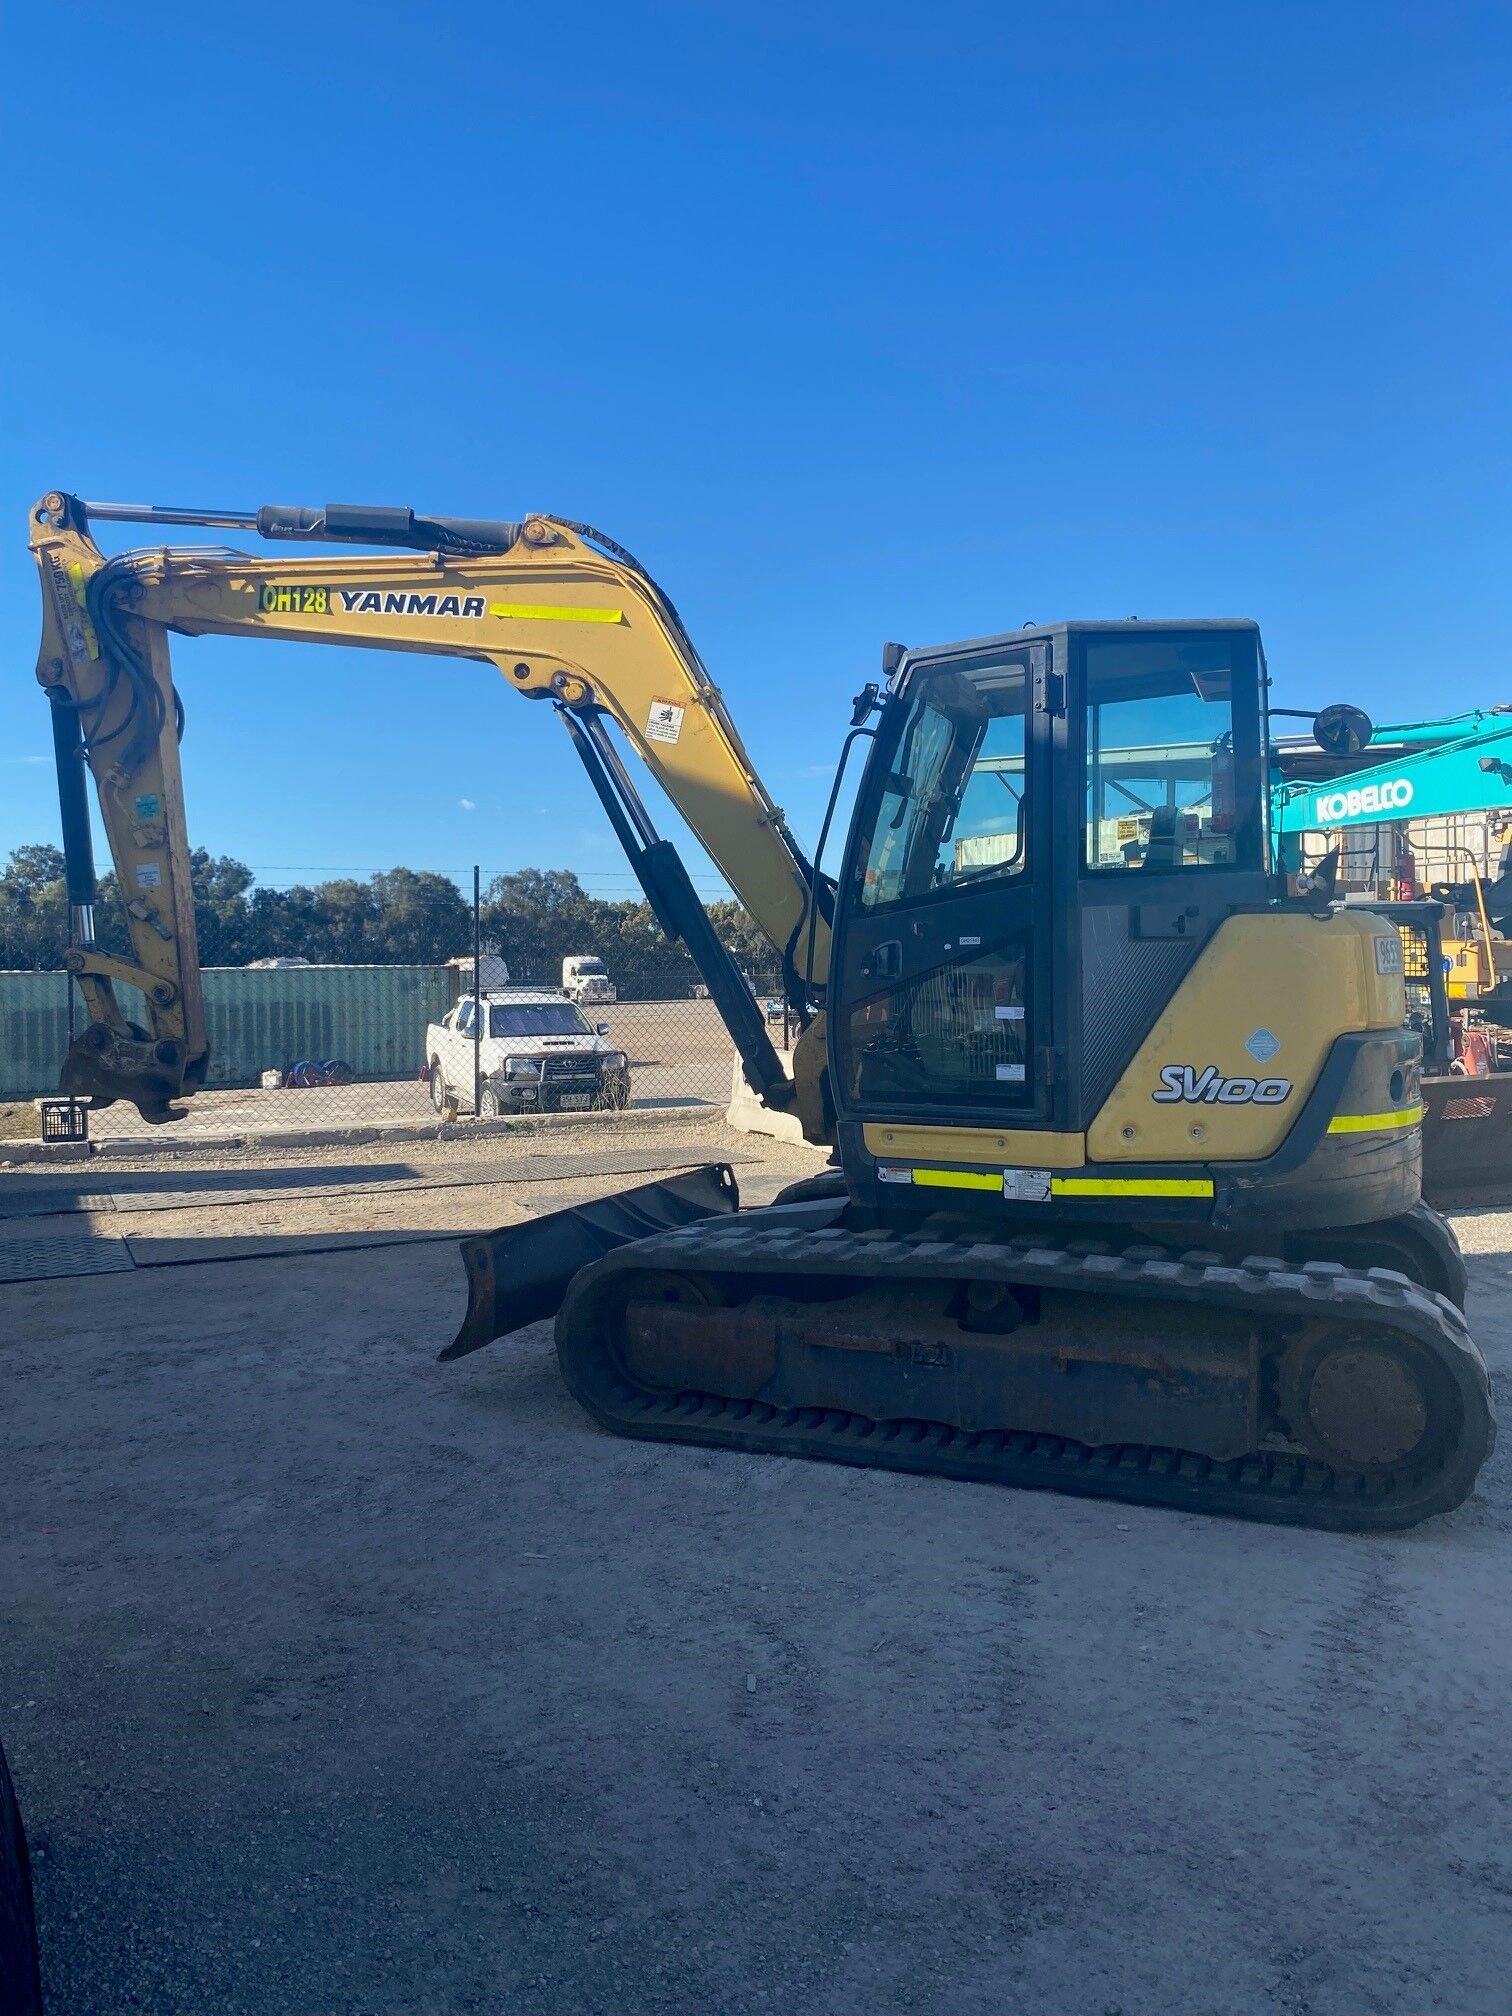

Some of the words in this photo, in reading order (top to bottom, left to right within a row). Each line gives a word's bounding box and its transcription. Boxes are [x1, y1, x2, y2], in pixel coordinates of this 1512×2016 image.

[262, 585, 326, 612] OH128
[338, 590, 486, 618] YANMAR
[1317, 779, 1413, 822] KOBELCO
[1152, 1065, 1294, 1105] SV100
